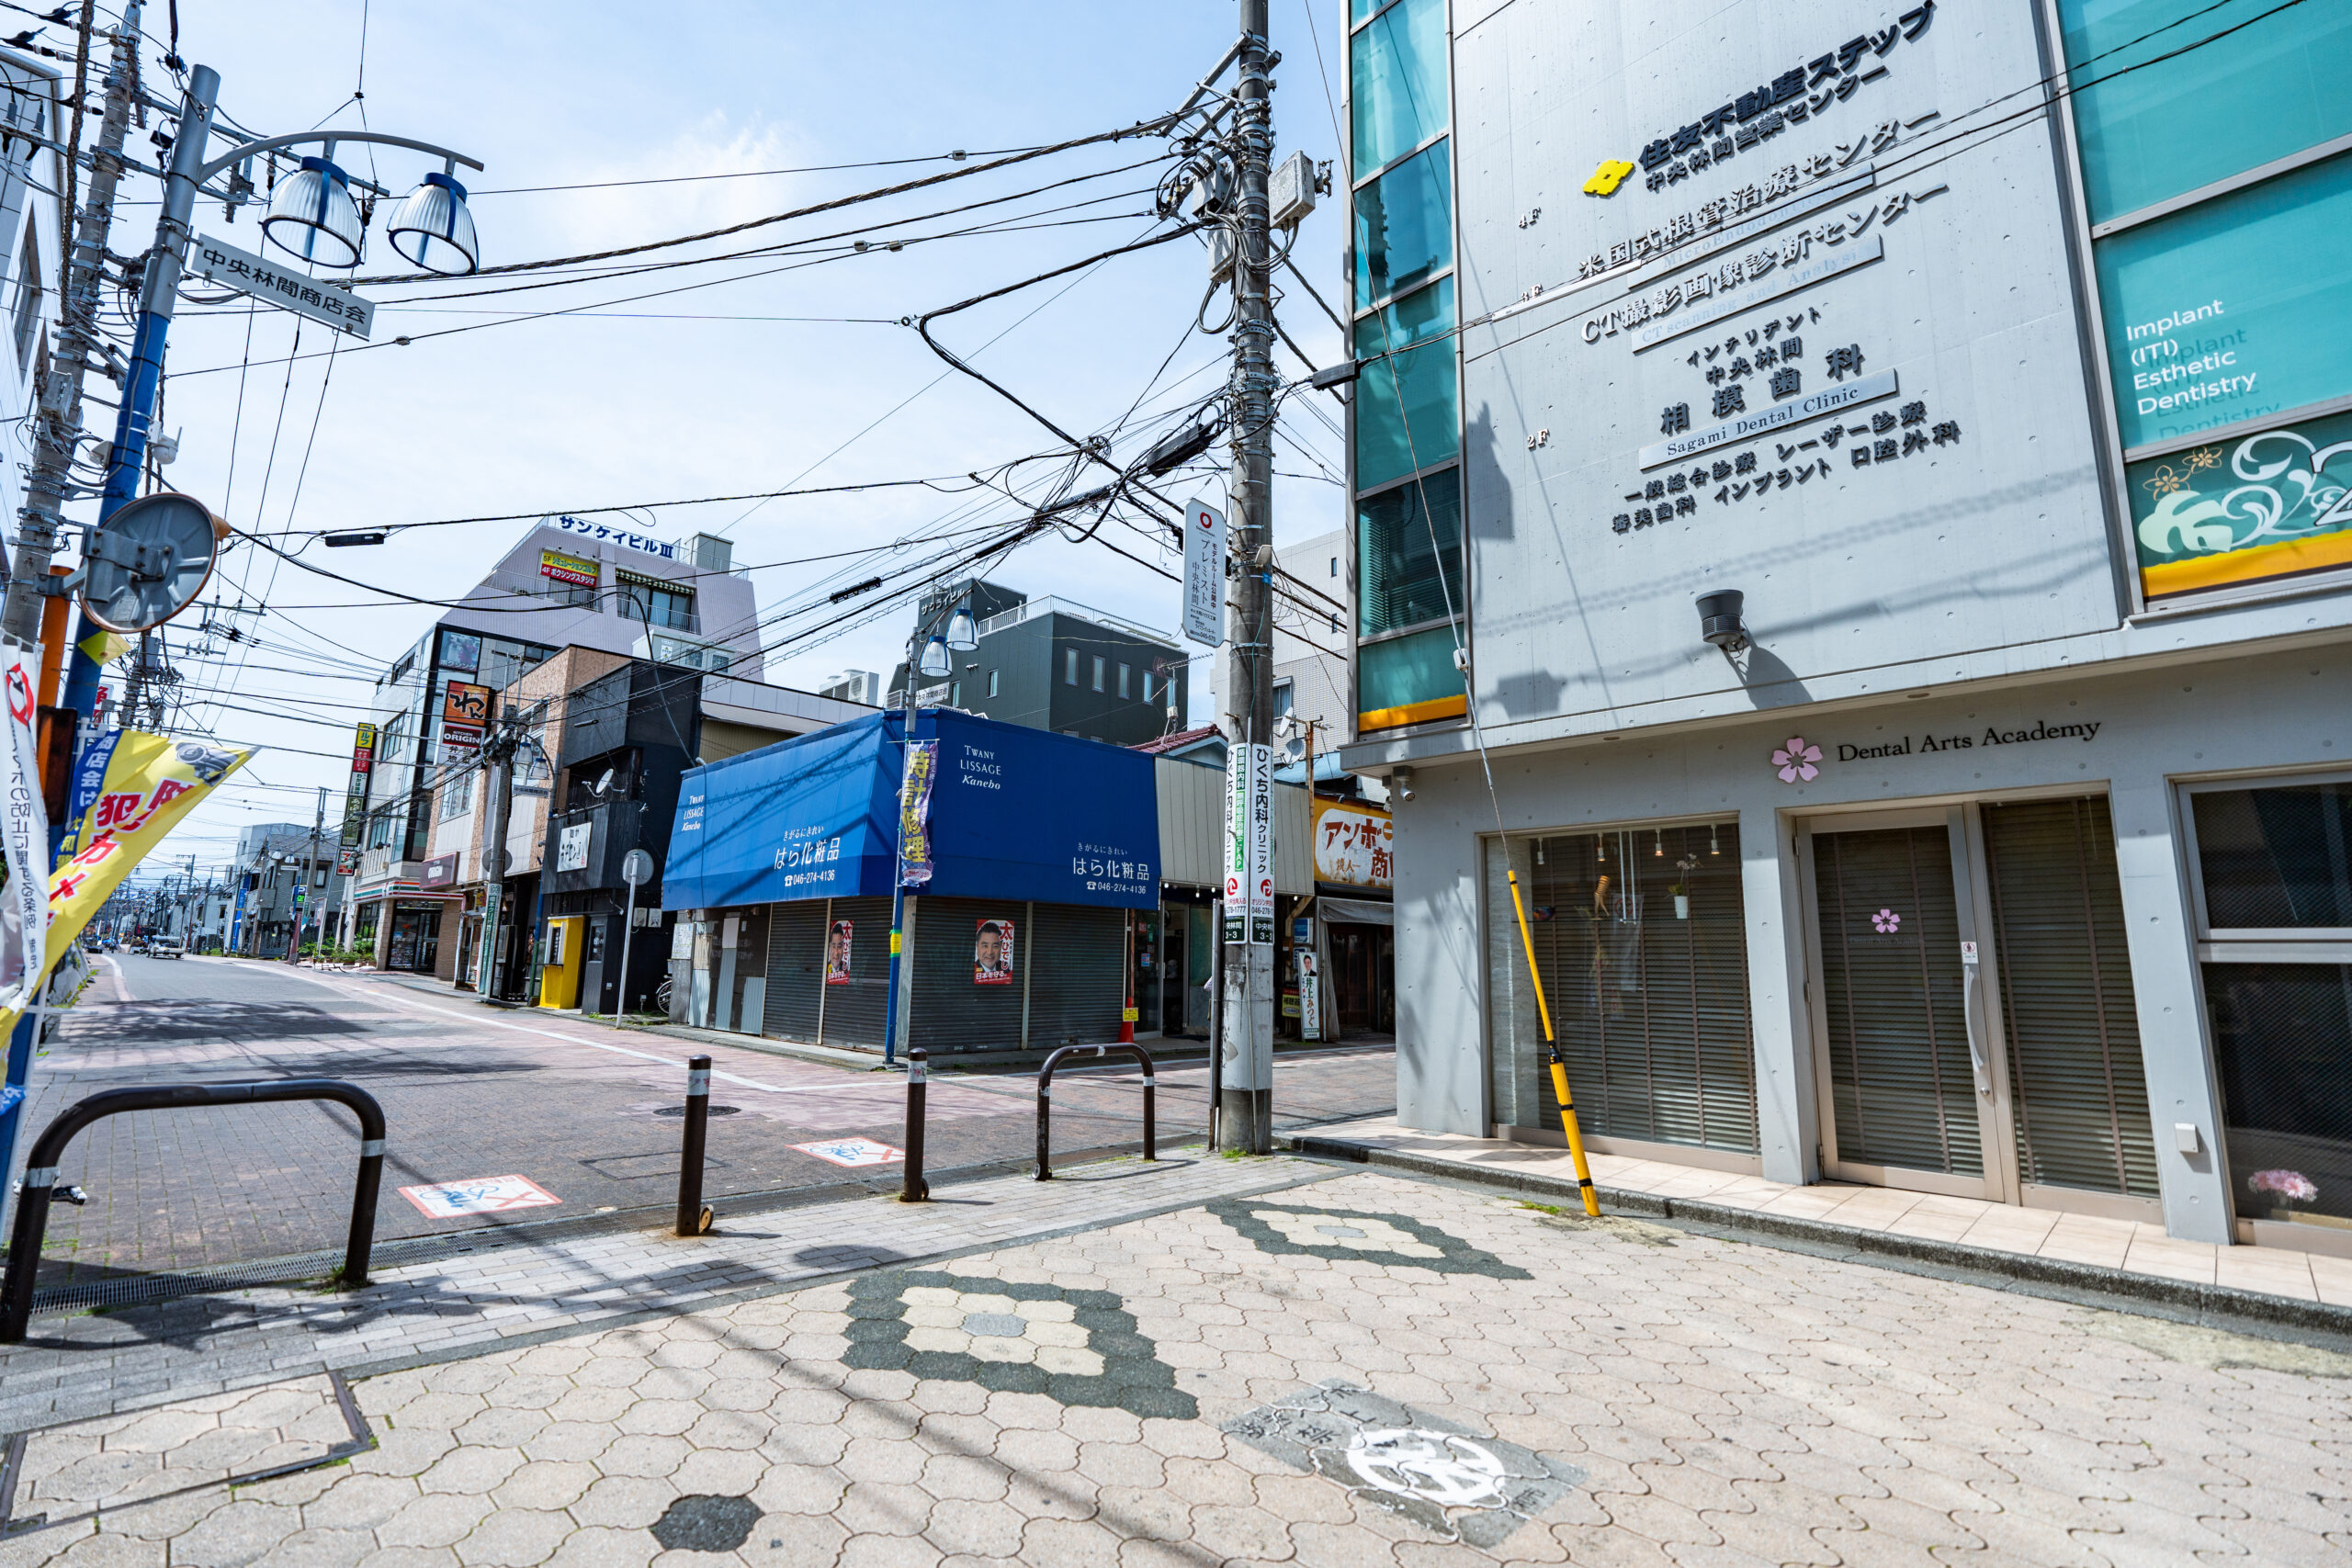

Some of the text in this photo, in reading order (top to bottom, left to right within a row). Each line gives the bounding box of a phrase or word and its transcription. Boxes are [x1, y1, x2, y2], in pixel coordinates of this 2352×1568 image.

[1638, 0, 1936, 171] 住友不動産ステップ
[1646, 66, 1888, 190] 中央林間営業センター
[1579, 109, 1939, 277] 米国式根管治療センター
[1581, 184, 1950, 343] CT撮影画像診断センター
[203, 248, 368, 324] 中央林間商店会
[1687, 306, 1822, 367] インテリデント
[2126, 299, 2224, 341] Implant
[1706, 336, 1803, 386] 中央林間
[2131, 338, 2179, 367] (ITI)
[2133, 351, 2236, 390] Esthetic
[1661, 344, 1865, 434] 相模歯科
[2137, 371, 2257, 415] Dentistry
[1528, 428, 1550, 450] 2F
[1667, 387, 1859, 457] Sagami Dental Clinic
[1624, 400, 1928, 503] 一般総合診療 レーザー診療
[1611, 420, 1962, 535] 審美歯科 インプラント 口腔外科
[542, 566, 595, 586] 4F ボクシングスタジオ
[552, 557, 596, 574] シミュレーションゴルフ
[444, 733, 481, 745] ORIGIN
[965, 745, 995, 761] TWANY
[1838, 720, 2102, 761] Dental Arts Academy
[960, 760, 1001, 775] LISSAGE
[962, 774, 1001, 790] Kanebo
[684, 807, 705, 819] LISSAGE
[901, 750, 930, 863] 時計修理
[1255, 748, 1269, 874] ひぐち内科クリニック
[775, 837, 841, 870] はら化粧品
[783, 826, 824, 841] きがるにきれい
[1077, 841, 1128, 855] きがるにきれい
[1073, 856, 1149, 881] はら化粧品
[1370, 846, 1394, 879] 商
[1097, 882, 1147, 895] 046-274-4136
[1000, 922, 1013, 970] 太ひでし
[1306, 976, 1316, 1028] 井上みつぐ
